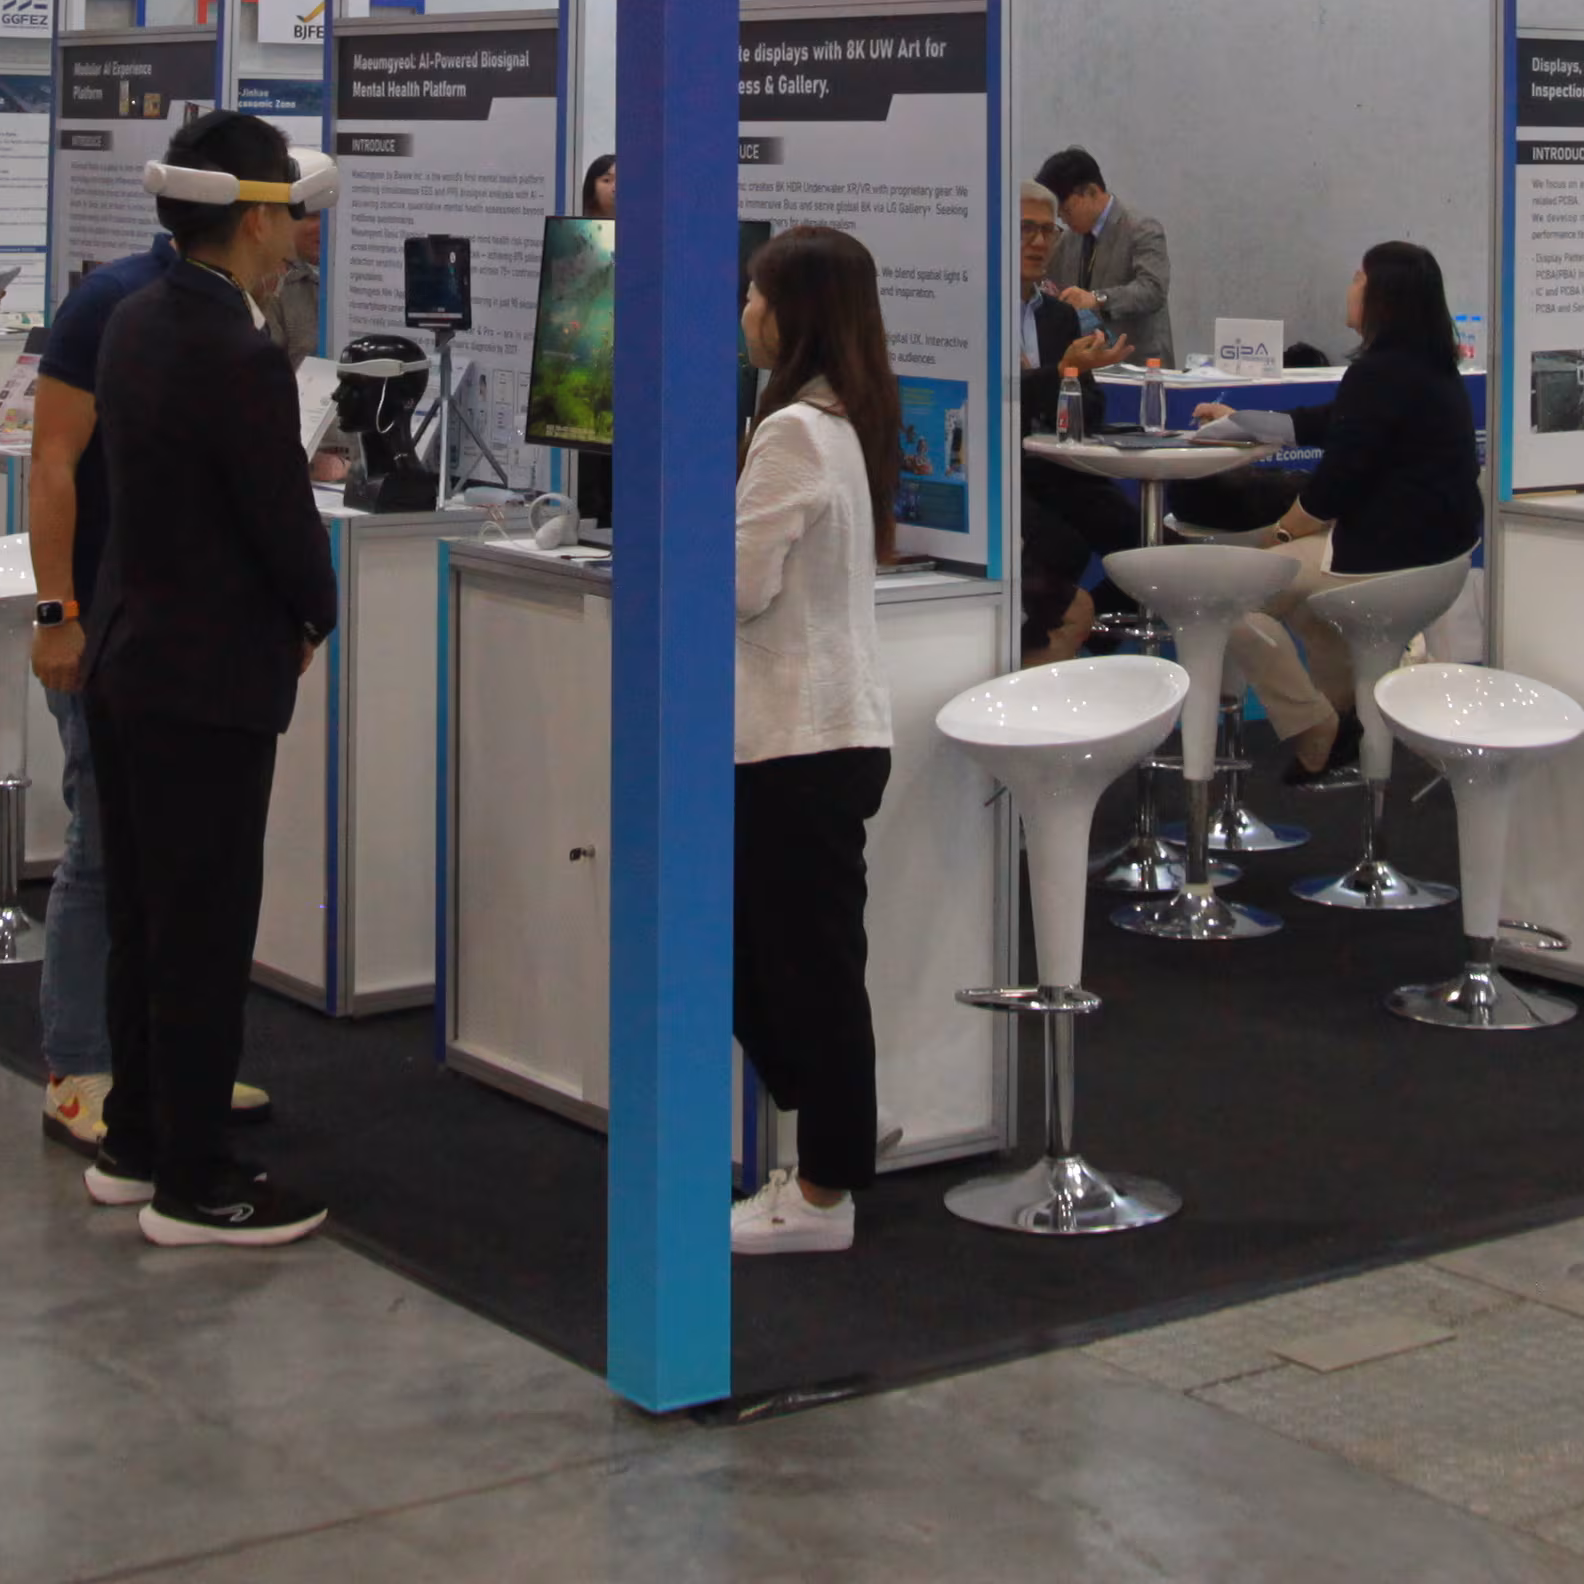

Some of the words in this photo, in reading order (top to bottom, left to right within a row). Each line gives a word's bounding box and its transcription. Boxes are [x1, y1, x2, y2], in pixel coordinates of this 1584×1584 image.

[1, 13, 49, 26] GGFEZ
[293, 24, 325, 41] BJFE
[754, 41, 809, 66] displays
[812, 41, 843, 61] with
[846, 38, 866, 60] 8K
[869, 38, 894, 59] UW
[897, 37, 921, 59] Art
[924, 36, 947, 58] for
[111, 60, 153, 80] Experience
[418, 51, 479, 70] AI-Powered
[480, 50, 531, 72] Biosignal
[1531, 56, 1583, 77] Displays,
[72, 85, 104, 101] Platform
[351, 80, 386, 98] Mental
[387, 80, 421, 98] Health
[422, 79, 467, 98] Platform
[764, 76, 775, 95] &
[777, 74, 830, 99] Gallery.
[351, 138, 397, 153] INTRODUCE
[1275, 447, 1325, 462] Econom
